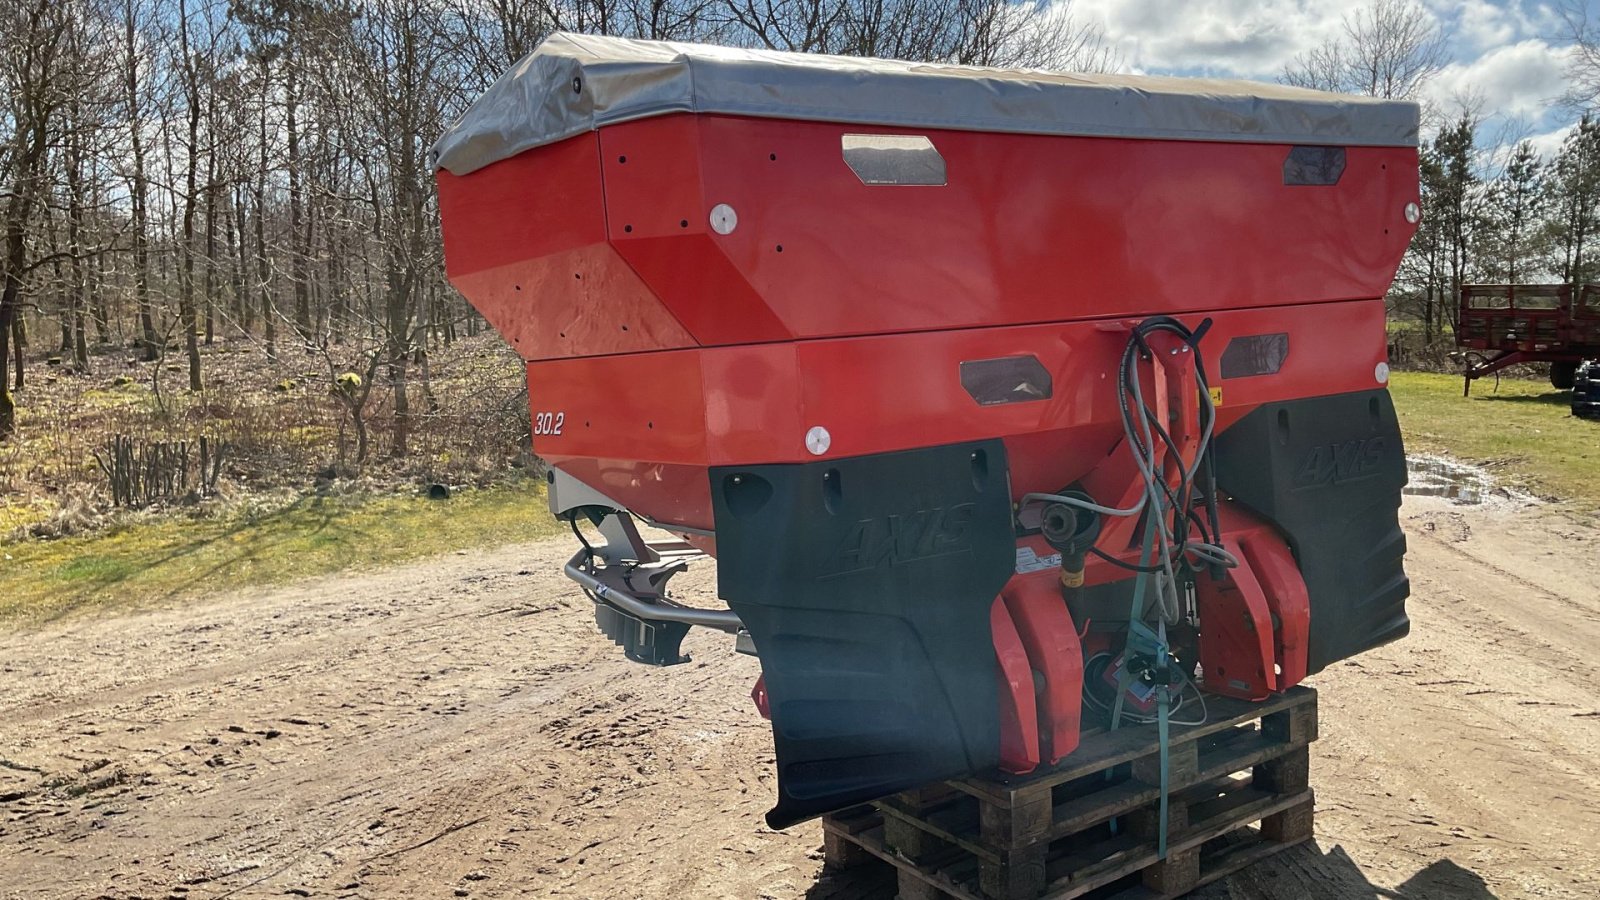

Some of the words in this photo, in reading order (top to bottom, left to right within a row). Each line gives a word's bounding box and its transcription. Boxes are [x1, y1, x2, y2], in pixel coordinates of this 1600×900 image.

[534, 411, 564, 435] 30.2
[1293, 437, 1384, 487] AXIS
[825, 502, 977, 571] AXIS
